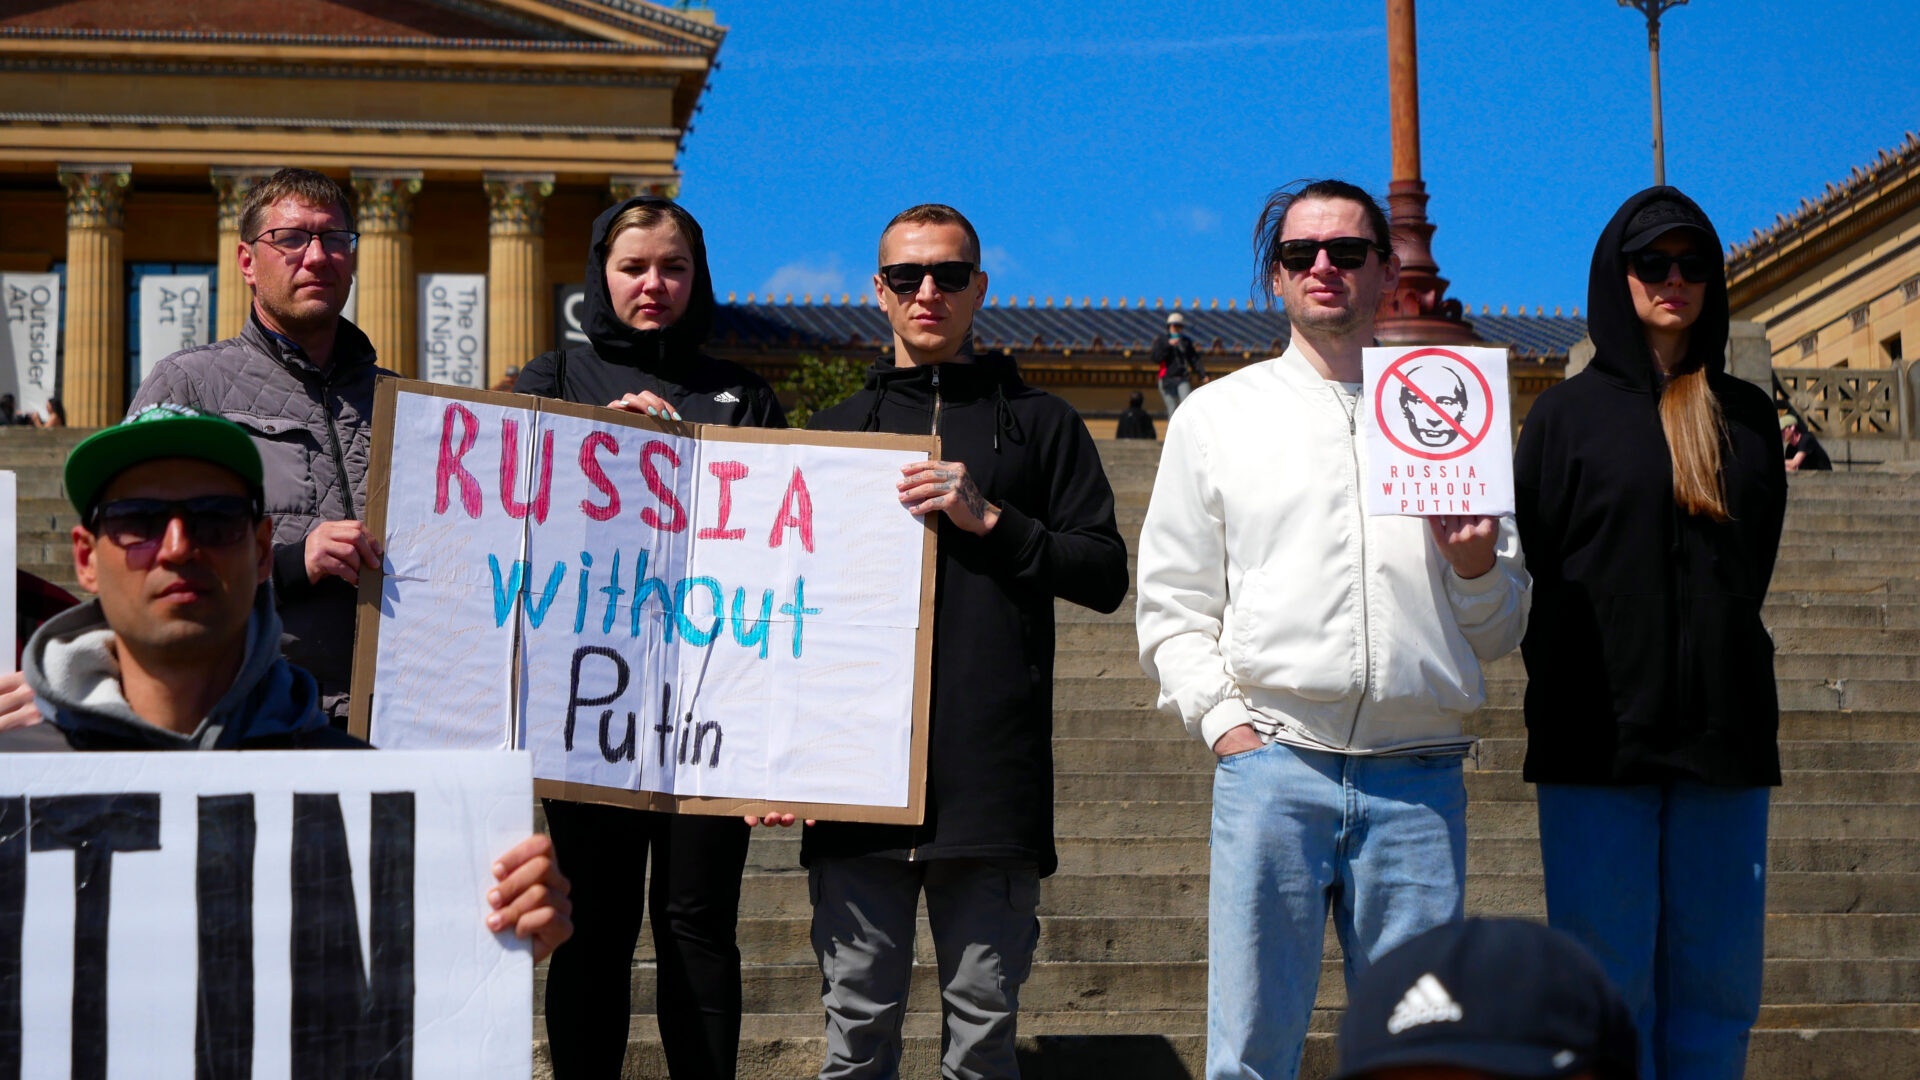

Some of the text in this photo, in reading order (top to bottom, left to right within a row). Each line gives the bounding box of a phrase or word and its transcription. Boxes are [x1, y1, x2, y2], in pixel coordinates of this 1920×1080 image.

[9, 284, 28, 324] Art
[28, 285, 51, 389] Outsider
[160, 287, 178, 324] Art
[425, 285, 453, 378] of Night
[453, 285, 479, 388] The Orig
[433, 402, 815, 553] RUSSIA
[1382, 482, 1486, 495] WITHOUT
[1391, 465, 1476, 478] RUSSIA
[1401, 499, 1470, 512] PUTIN
[487, 548, 823, 659] without
[563, 645, 723, 768] Putin
